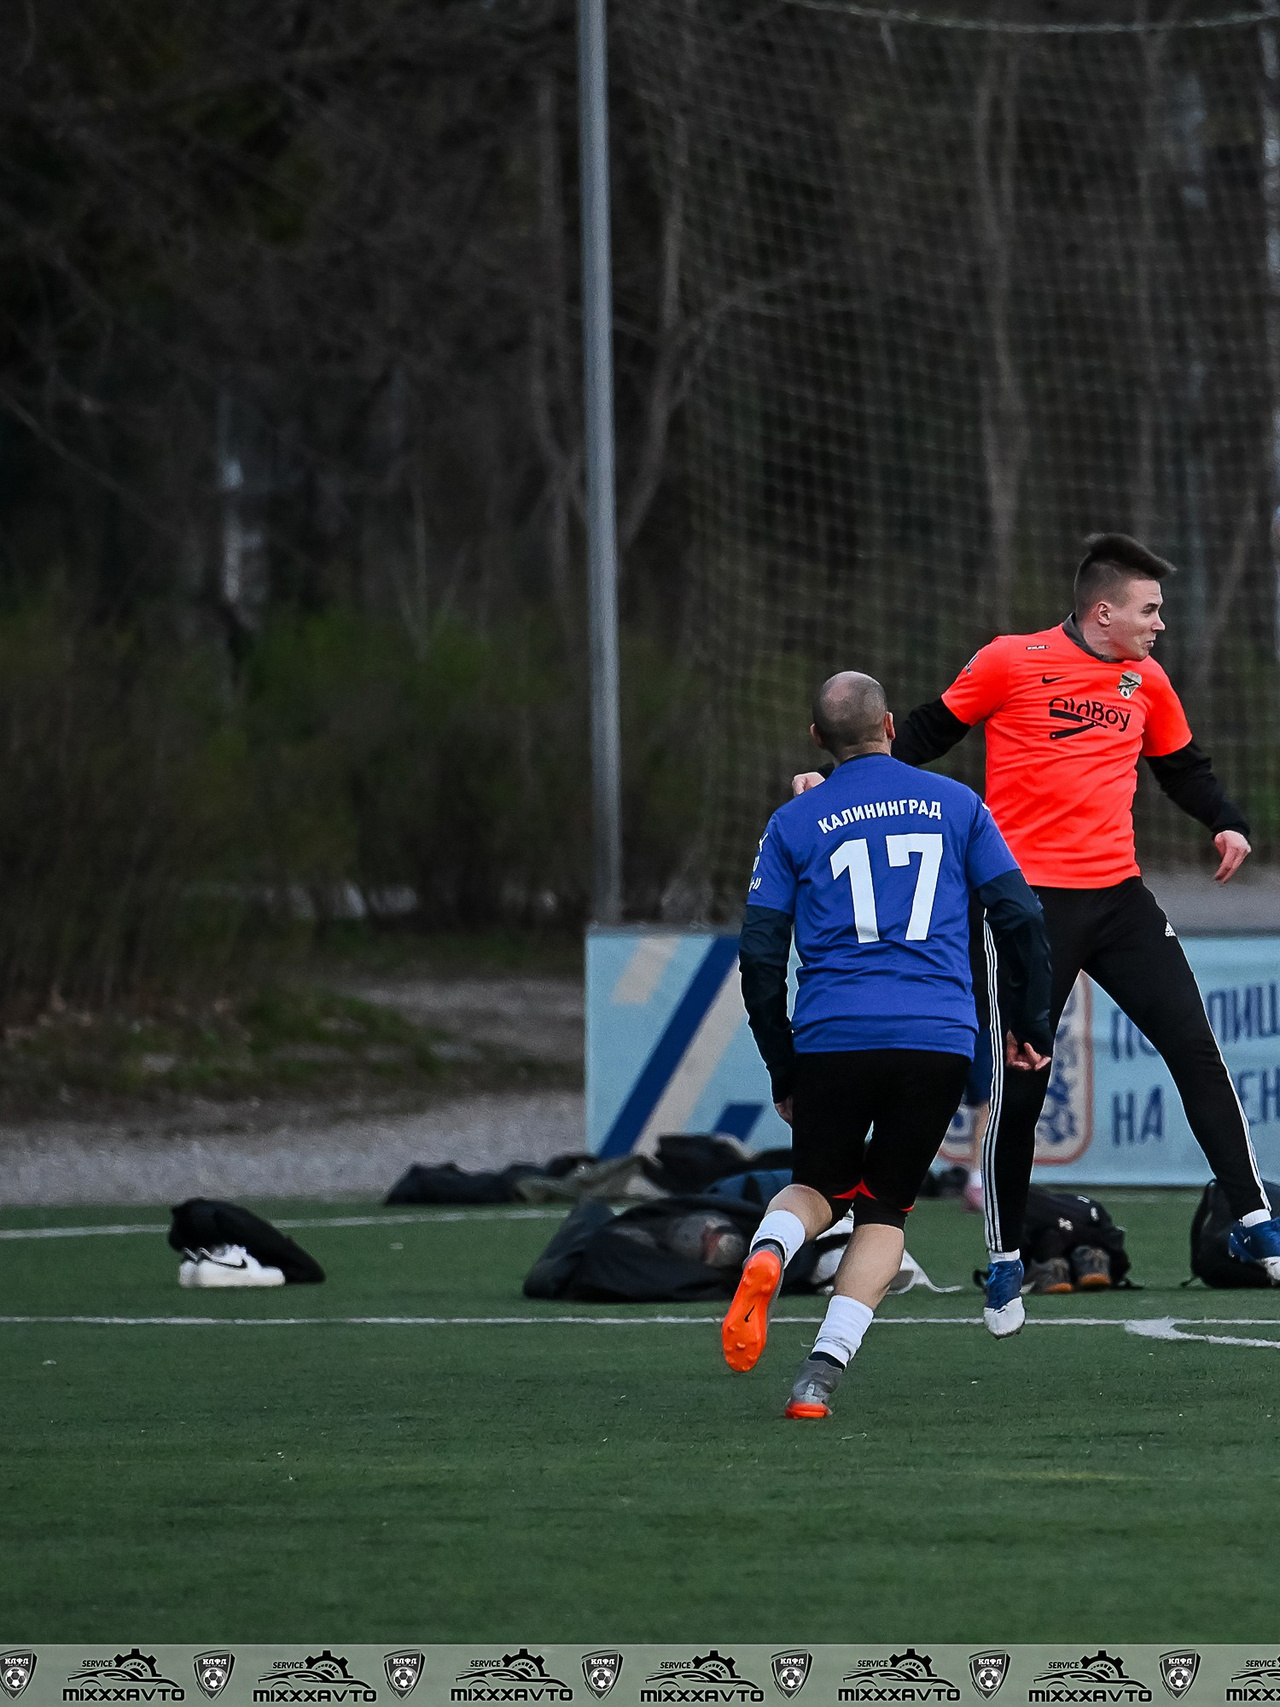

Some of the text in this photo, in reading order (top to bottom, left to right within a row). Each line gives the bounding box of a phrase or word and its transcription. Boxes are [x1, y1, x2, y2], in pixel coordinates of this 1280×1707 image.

[1048, 697, 1131, 732] OldBoy
[817, 799, 942, 833] КАЛИНИНГРАД
[829, 833, 943, 944] 17
[1111, 1084, 1163, 1145] НА
